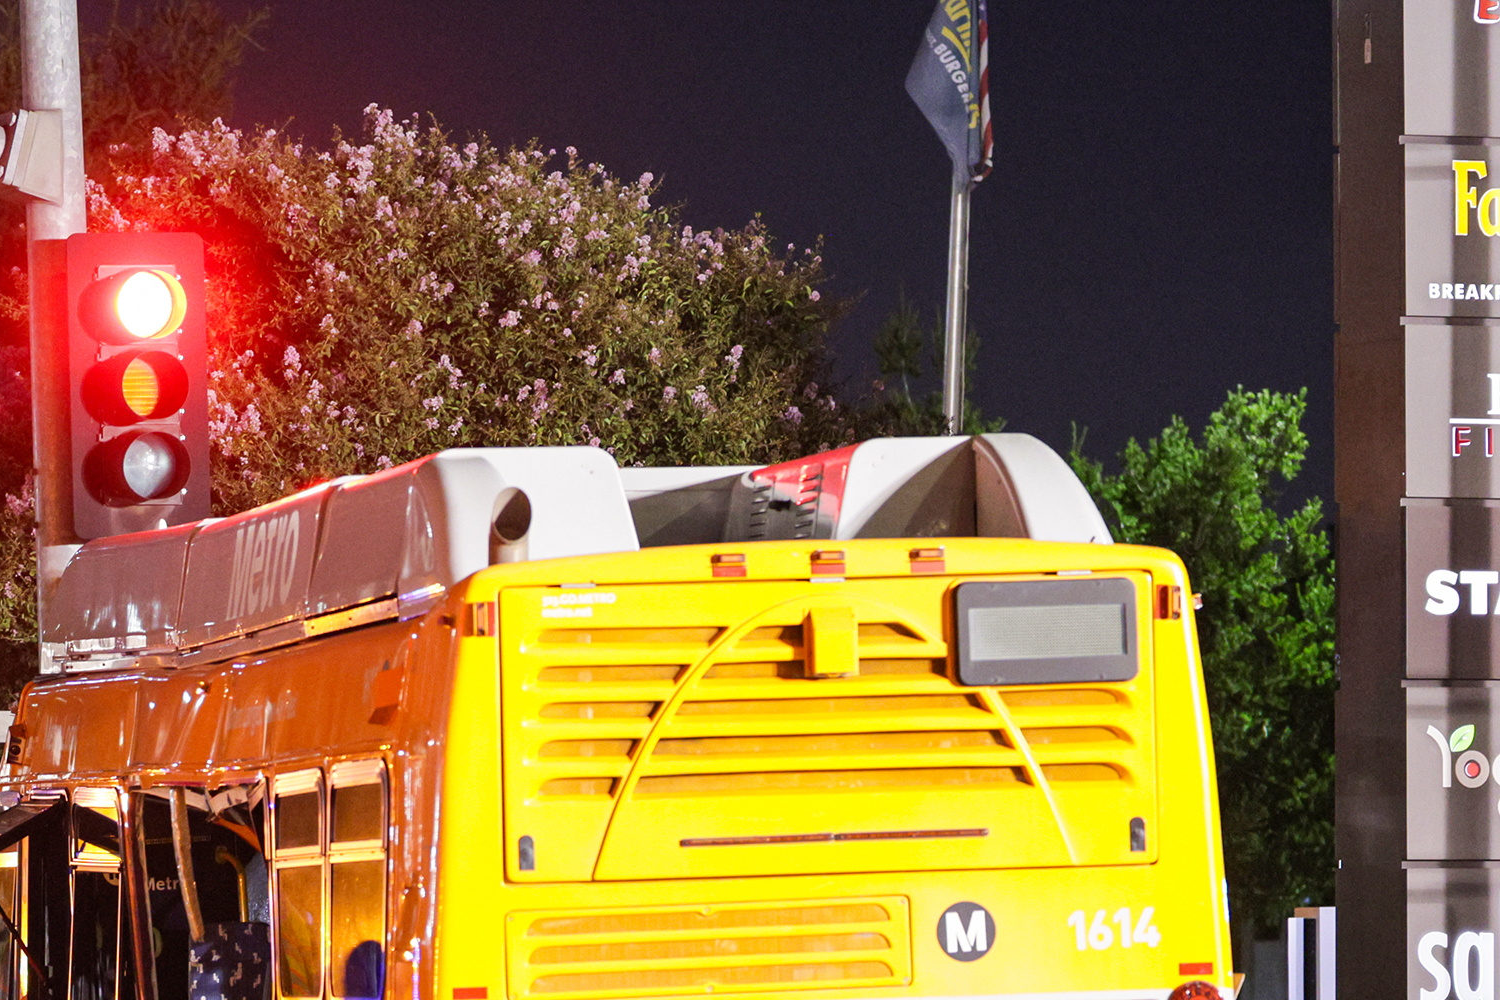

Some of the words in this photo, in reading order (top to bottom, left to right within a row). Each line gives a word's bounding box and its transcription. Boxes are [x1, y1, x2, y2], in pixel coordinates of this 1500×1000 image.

[225, 511, 300, 621] Metro
[1425, 569, 1500, 615] ST
[1067, 906, 1161, 951] 1614
